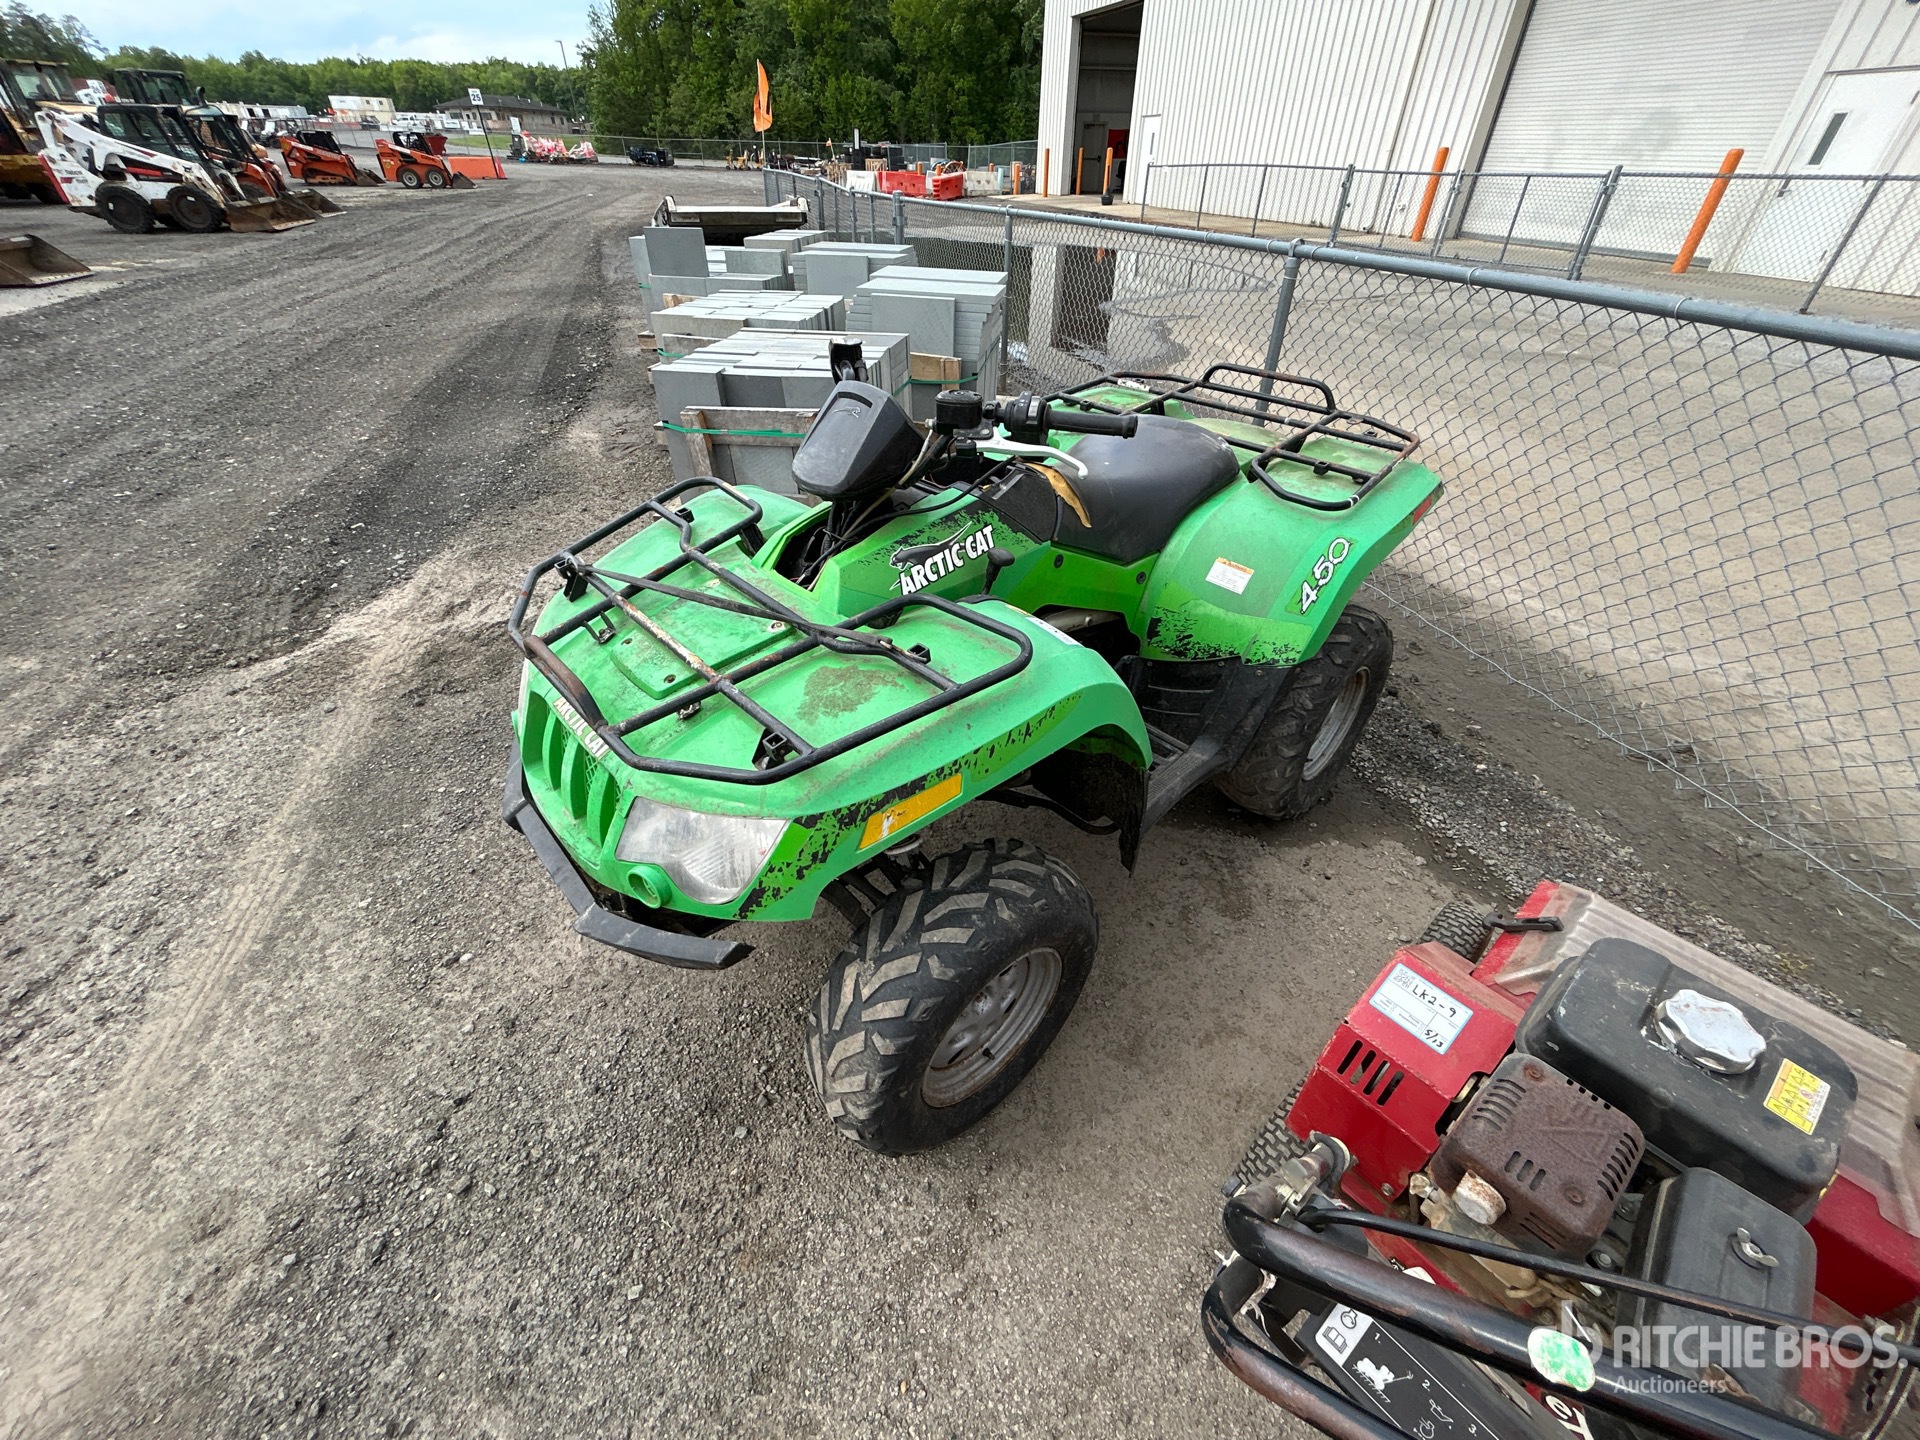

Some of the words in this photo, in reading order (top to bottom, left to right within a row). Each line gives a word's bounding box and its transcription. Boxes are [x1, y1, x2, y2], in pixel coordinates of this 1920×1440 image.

[899, 542, 965, 596] ARCTIC
[964, 524, 995, 560] CAT
[1299, 536, 1352, 615] 450
[1421, 1379, 1431, 1392] 2.
[1468, 1423, 1477, 1437] 3.
